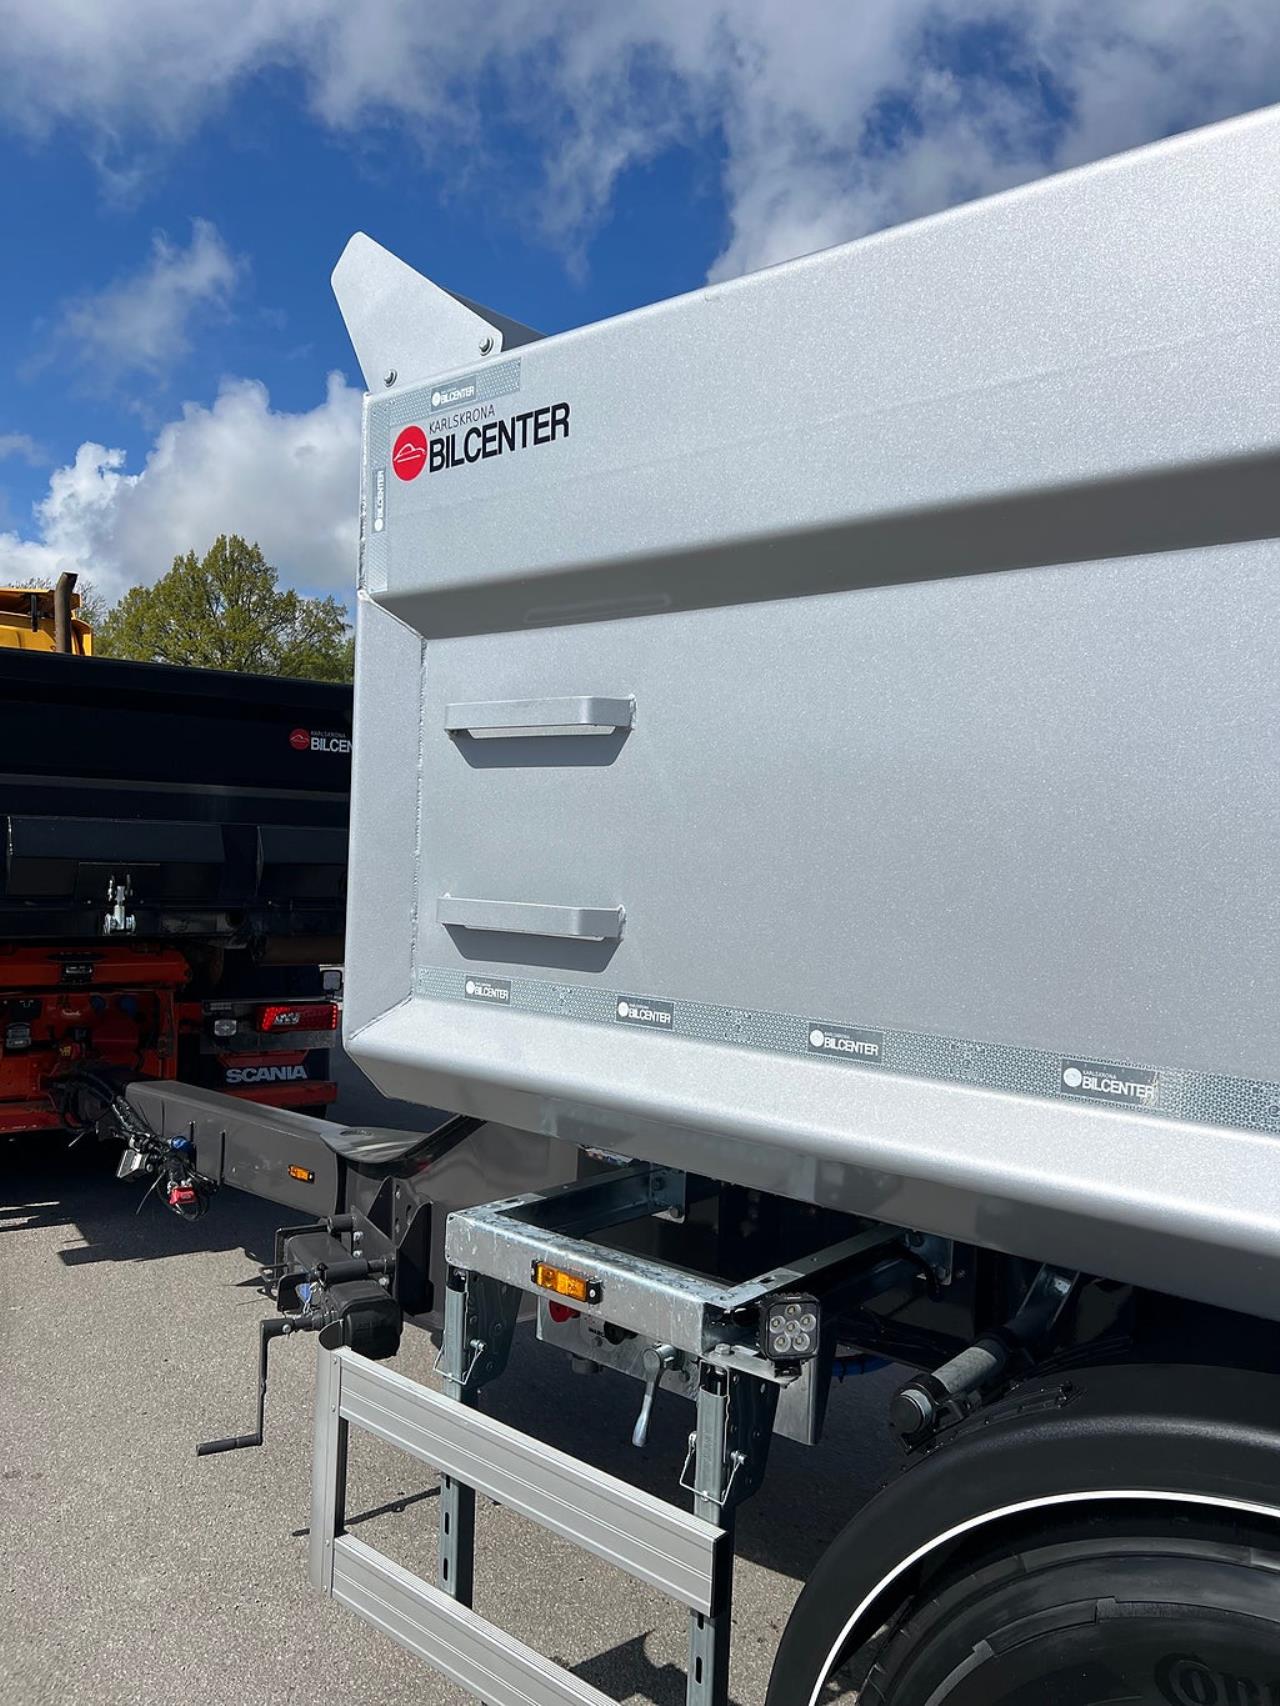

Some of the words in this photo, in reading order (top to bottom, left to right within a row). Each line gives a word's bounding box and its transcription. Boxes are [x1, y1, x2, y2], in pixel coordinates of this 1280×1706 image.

[429, 404, 495, 434] KARLSKRONA
[429, 402, 570, 473] BILCENTER
[475, 986, 508, 1000] BILCENTER
[629, 1008, 671, 1023] BILCENTER
[825, 1036, 879, 1056] BILCENTER
[226, 1066, 307, 1083] SCANIA
[1082, 1076, 1154, 1098] BILCENTER
